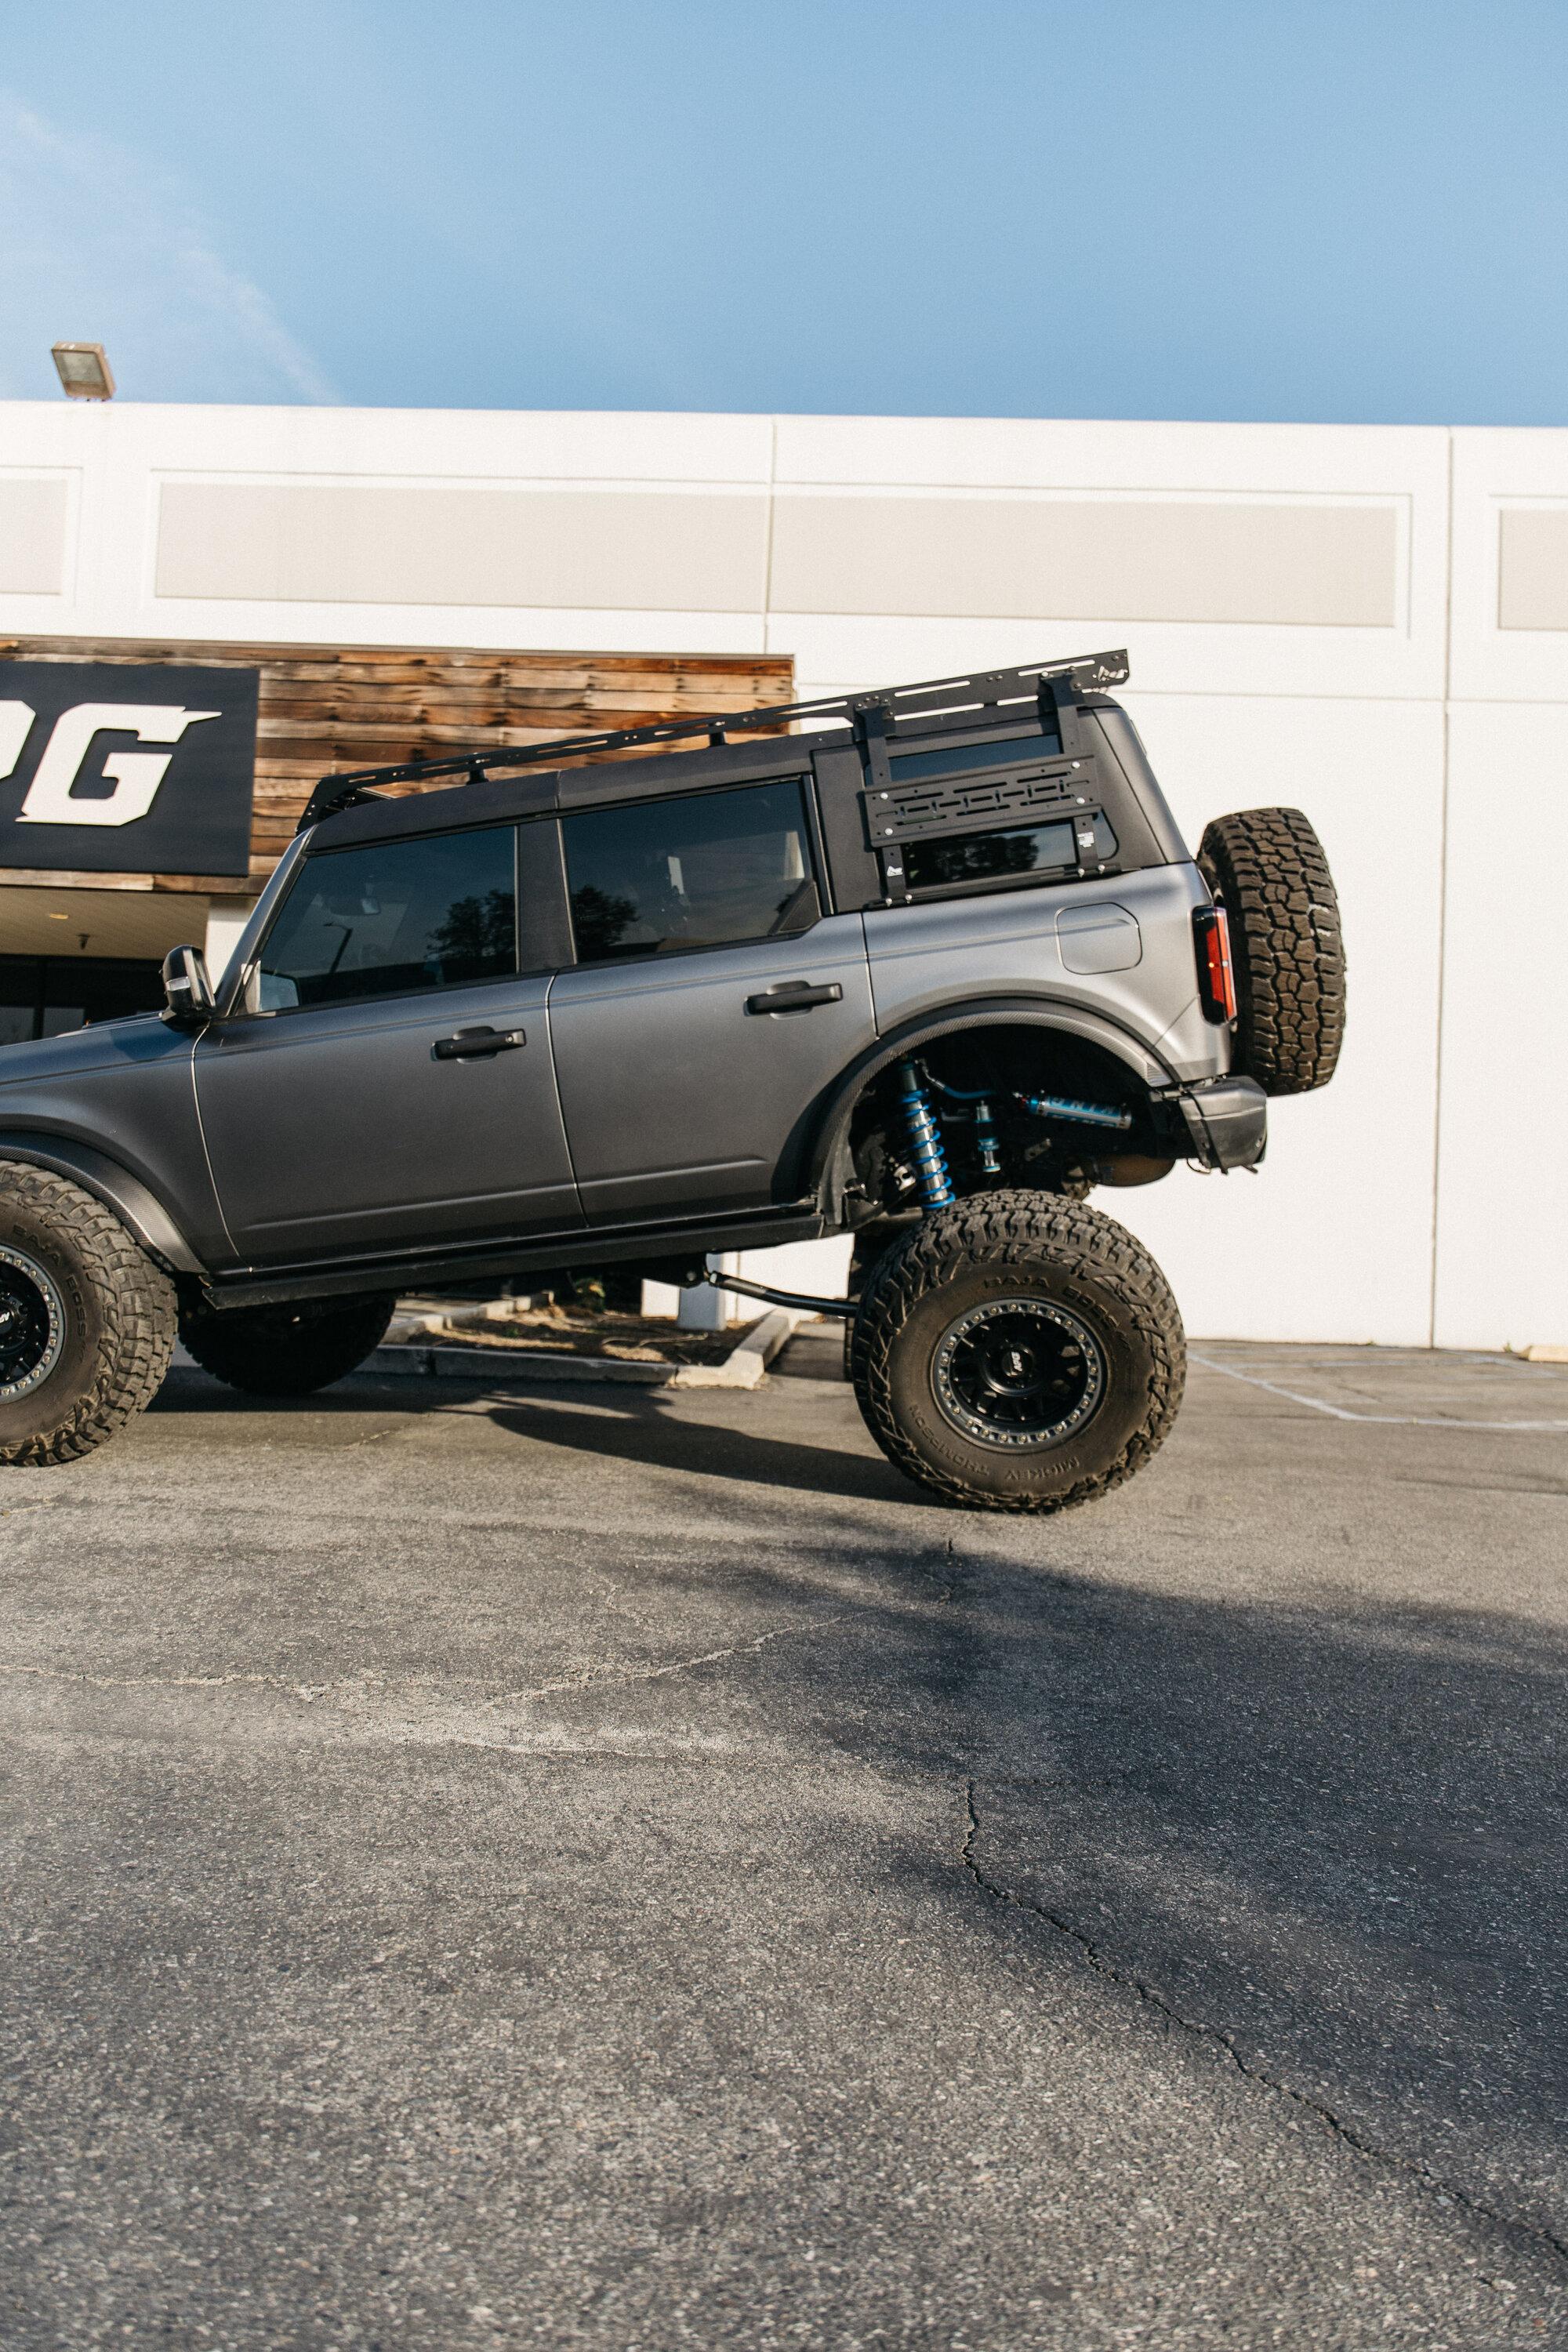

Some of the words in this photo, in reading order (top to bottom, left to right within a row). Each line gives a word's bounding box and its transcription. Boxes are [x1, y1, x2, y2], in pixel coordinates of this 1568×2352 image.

[983, 1274, 1051, 1289] BAJA
[66, 1274, 87, 1338] BOSS
[1004, 1455, 1080, 1481] MICKEY
